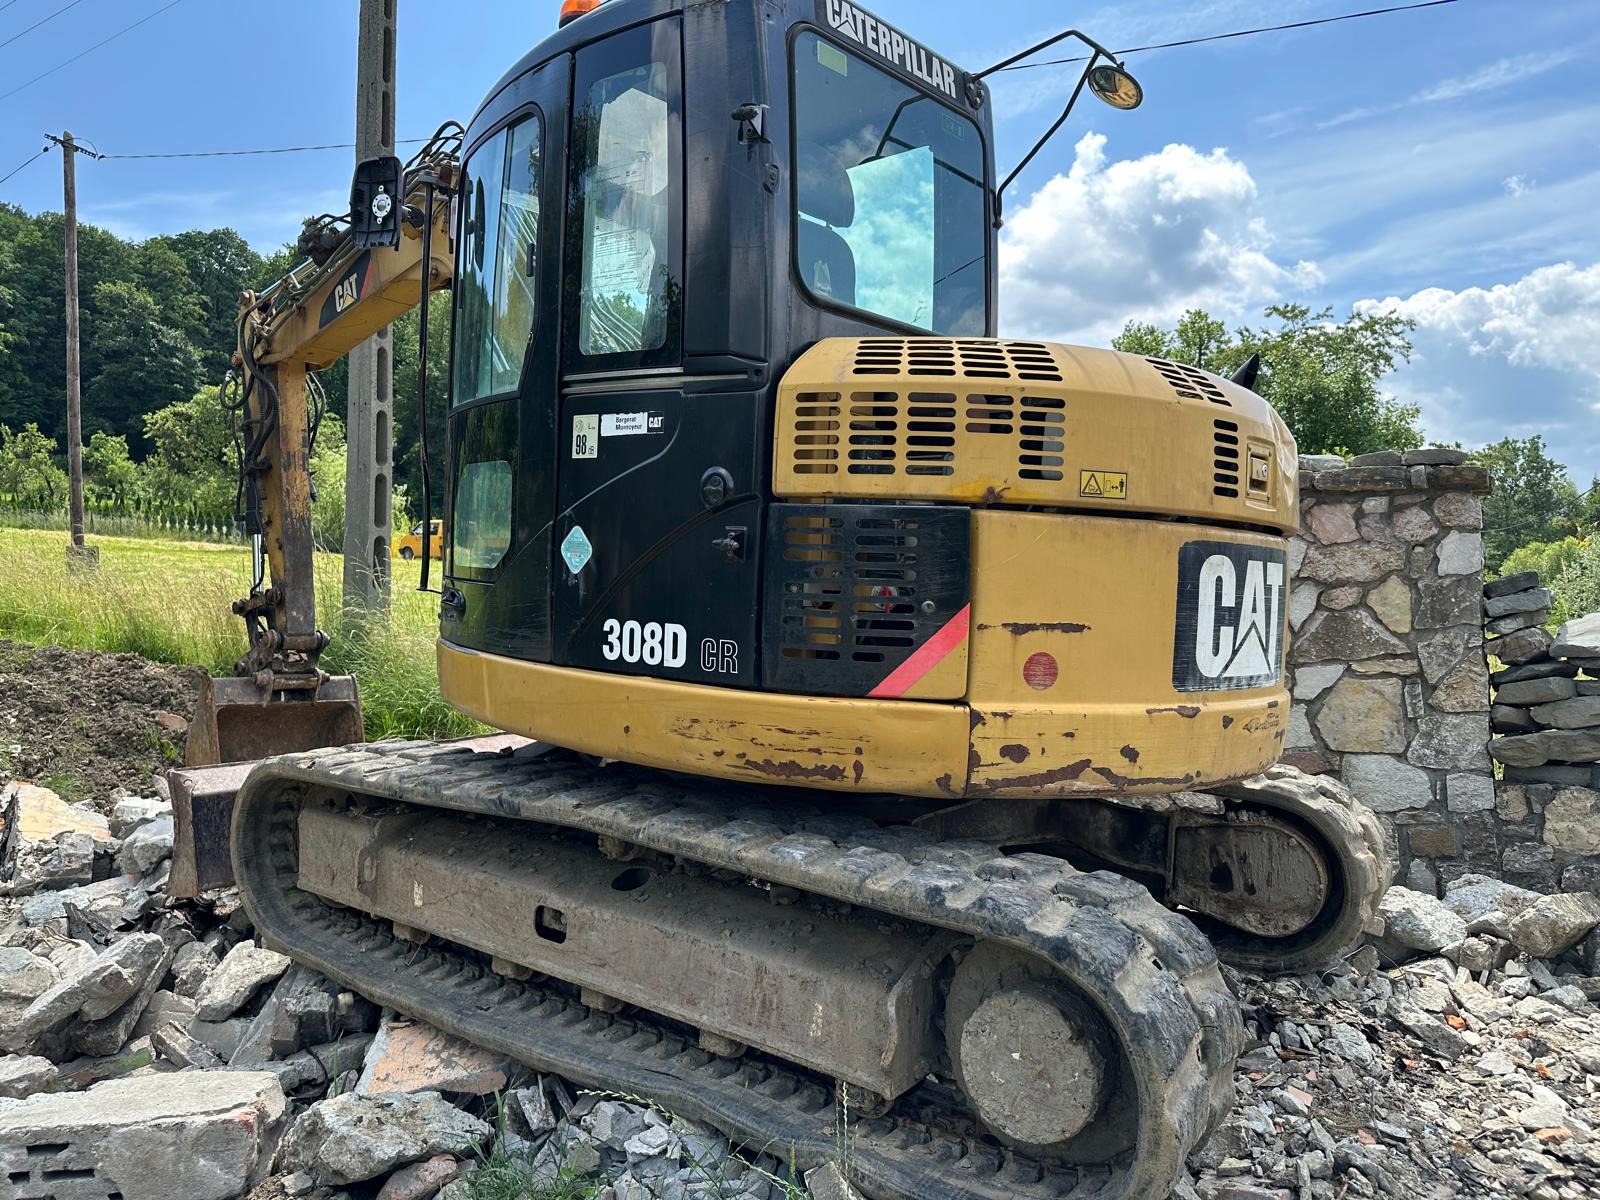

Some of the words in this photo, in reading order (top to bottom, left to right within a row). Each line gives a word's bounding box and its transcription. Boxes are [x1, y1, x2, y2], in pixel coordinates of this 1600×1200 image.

[826, 0, 956, 98] CATERPILLAR
[335, 272, 358, 312] CAT
[575, 434, 587, 455] 98
[648, 417, 664, 428] CAT
[1195, 554, 1284, 678] CAT
[602, 618, 687, 668] 308D
[700, 637, 738, 674] CR
